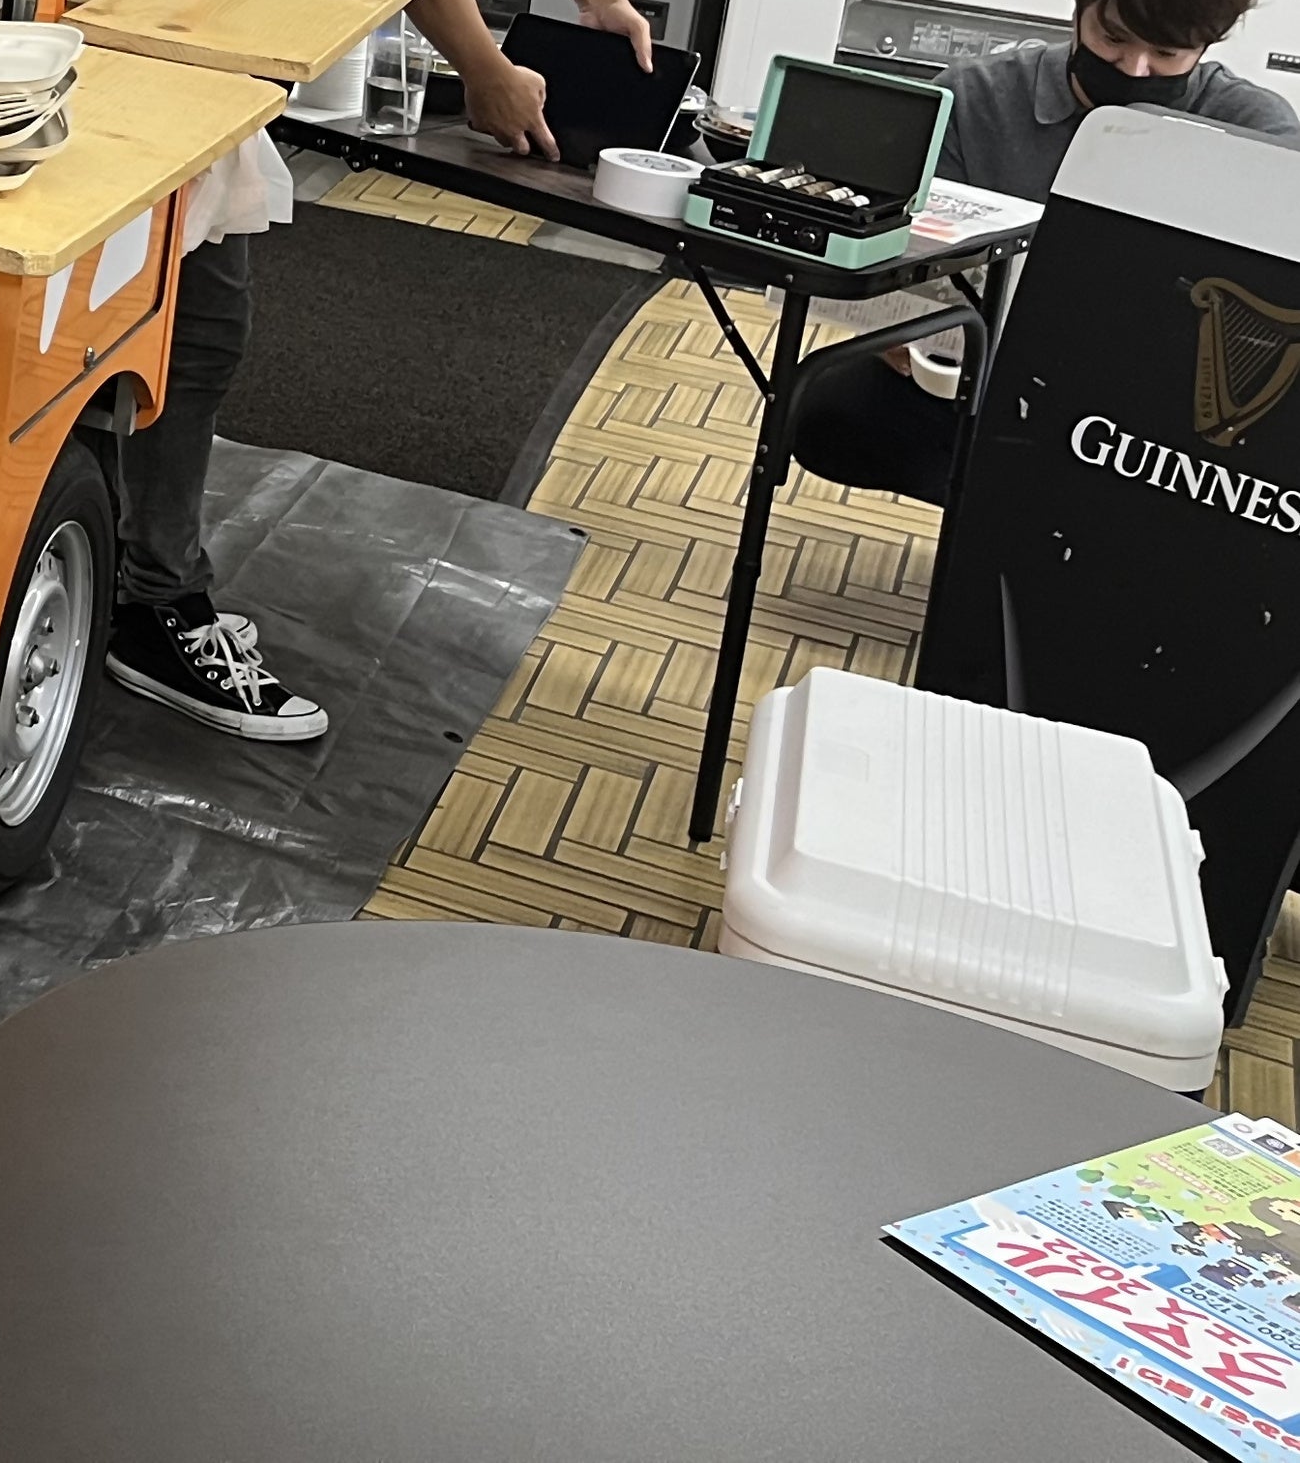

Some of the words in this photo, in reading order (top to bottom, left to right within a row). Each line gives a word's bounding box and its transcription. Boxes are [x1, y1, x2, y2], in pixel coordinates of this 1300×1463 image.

[1070, 415, 1300, 537] GUINNES
[1042, 1237, 1153, 1296] 2022
[1180, 1286, 1232, 1315] 17:00
[997, 1241, 1288, 1396] スマイル
[1155, 1297, 1293, 1376] フェス
